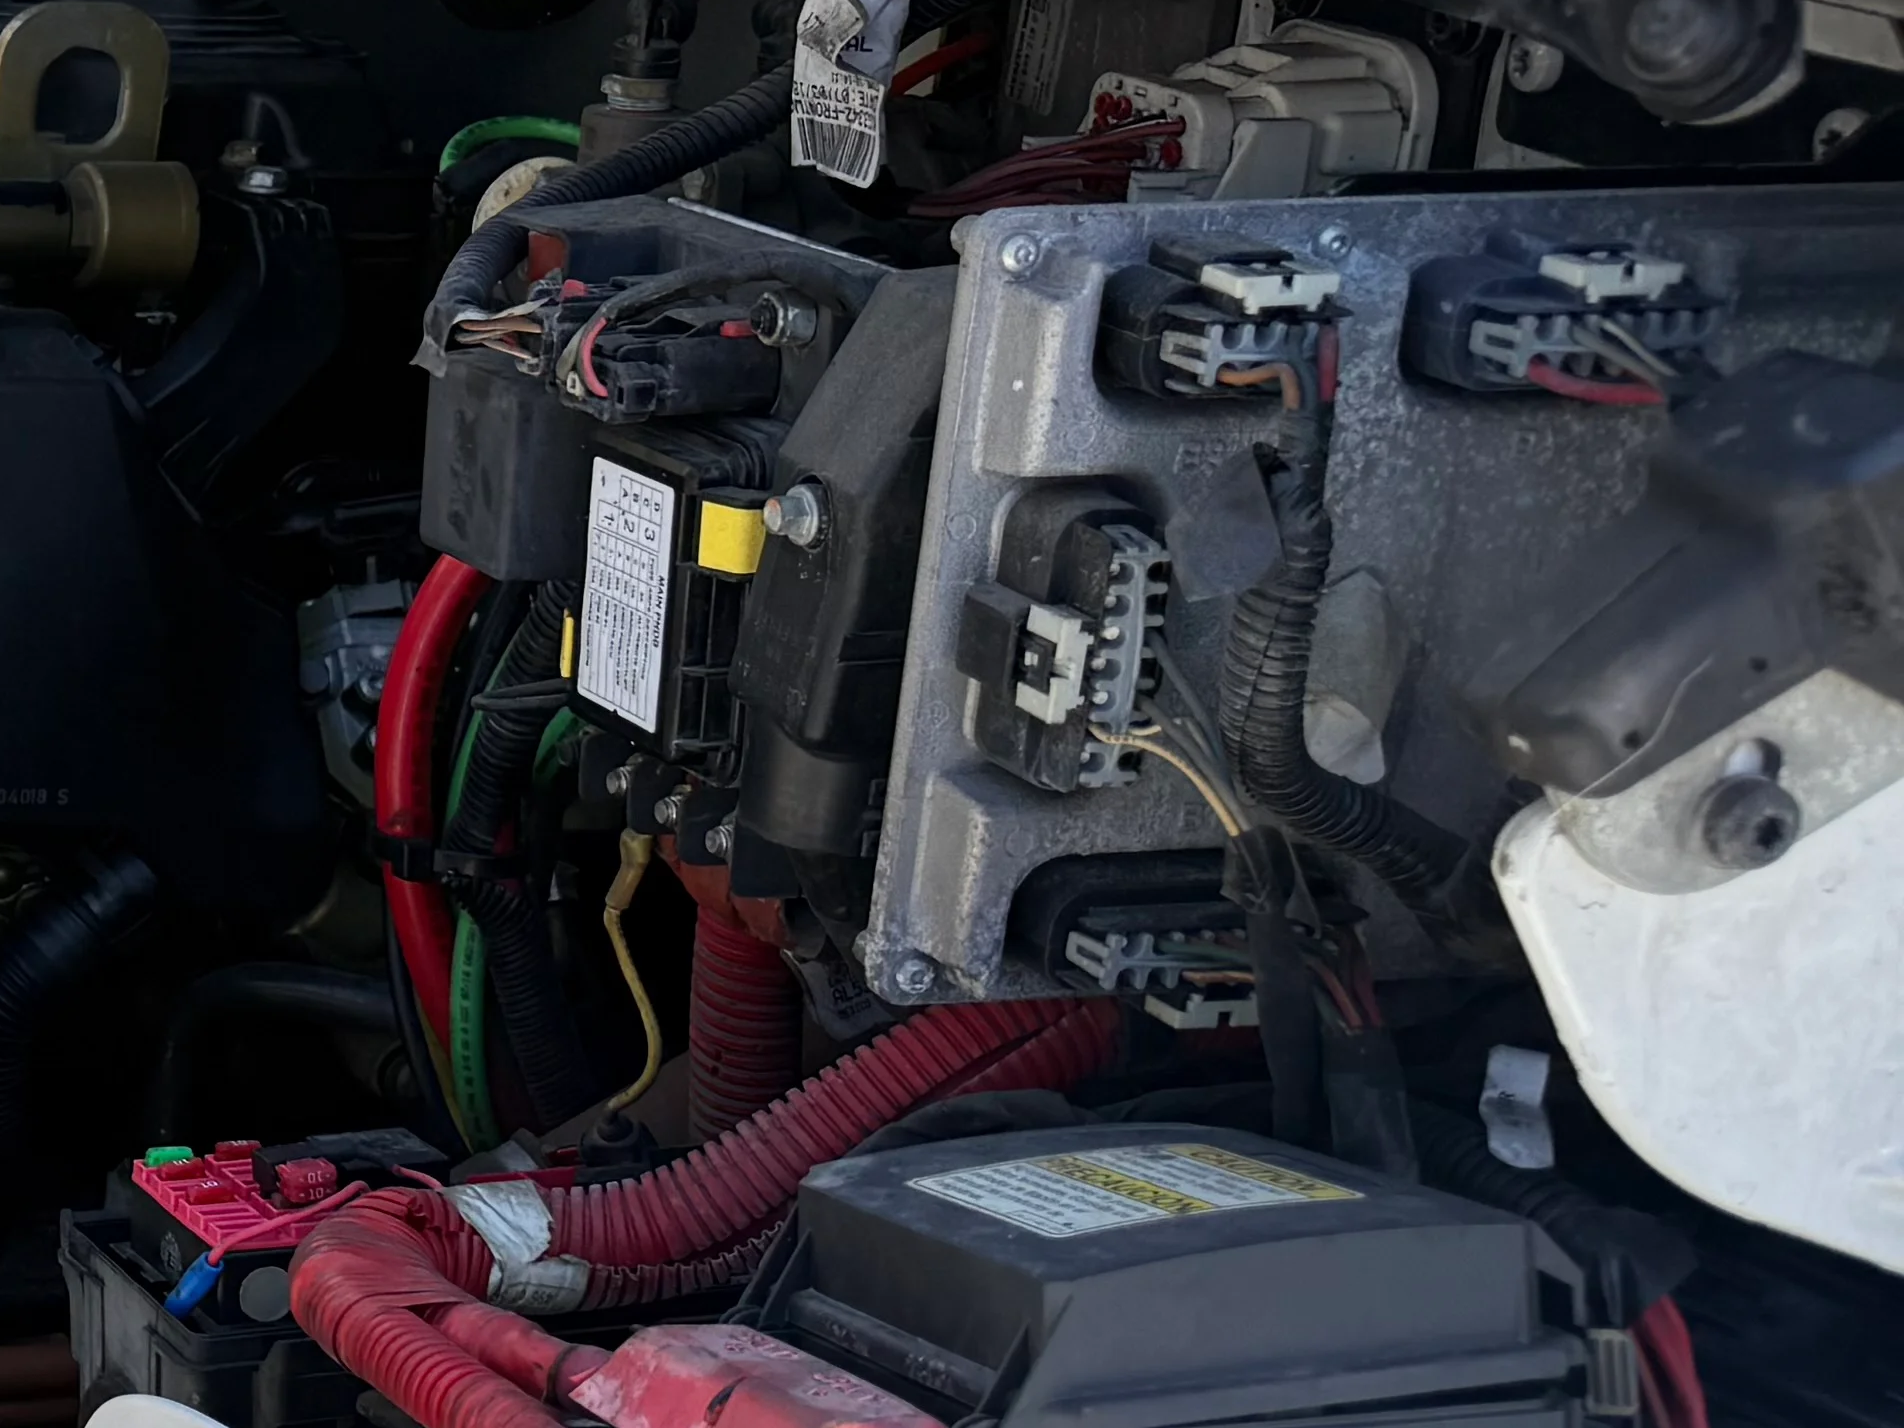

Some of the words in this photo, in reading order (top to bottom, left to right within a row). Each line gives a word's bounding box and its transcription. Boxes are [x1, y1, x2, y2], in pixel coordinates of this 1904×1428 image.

[623, 518, 634, 533] 2
[644, 527, 655, 541] 3
[654, 575, 666, 608] MAIN
[1190, 1151, 1318, 1192] CAUTION
